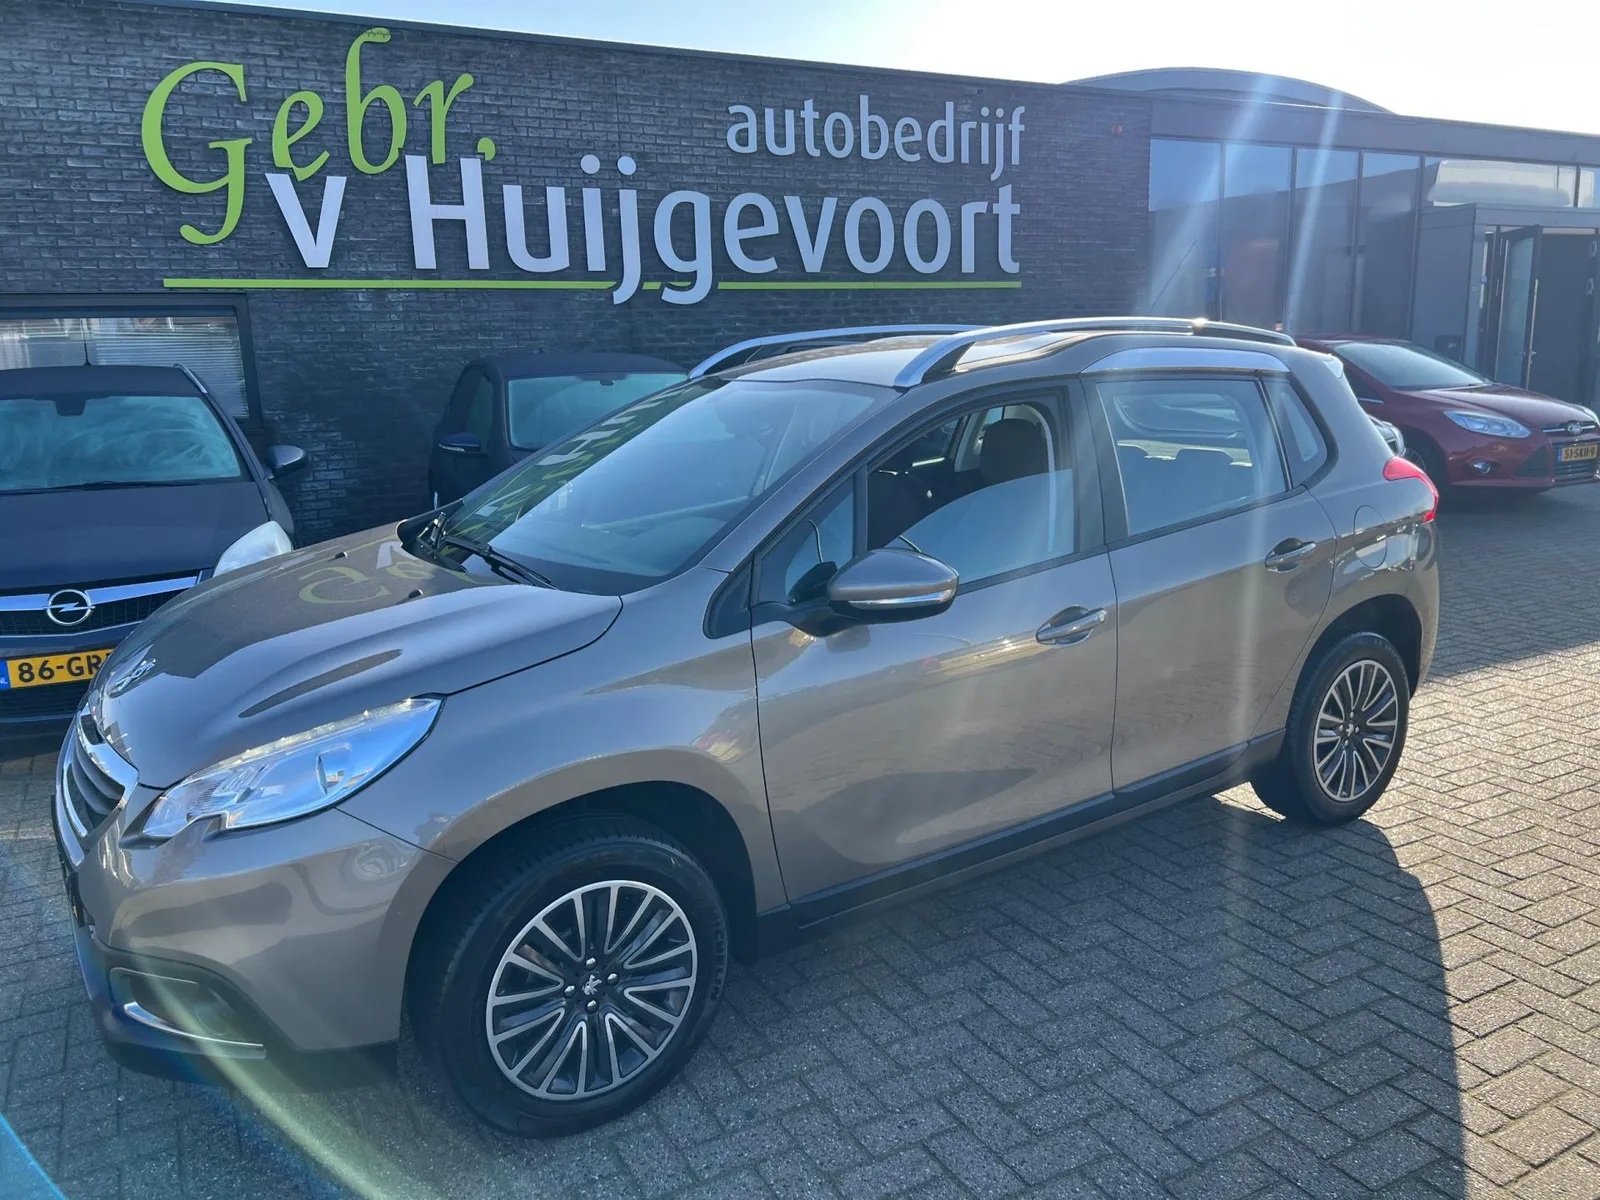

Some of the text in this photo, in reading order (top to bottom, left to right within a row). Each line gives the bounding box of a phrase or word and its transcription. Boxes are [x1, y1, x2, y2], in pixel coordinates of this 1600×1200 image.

[141, 28, 496, 245] Gebr.
[726, 94, 1026, 182] autobedrijf
[264, 154, 1021, 305] v Huijgevoort
[18, 652, 113, 683] 86-GR
